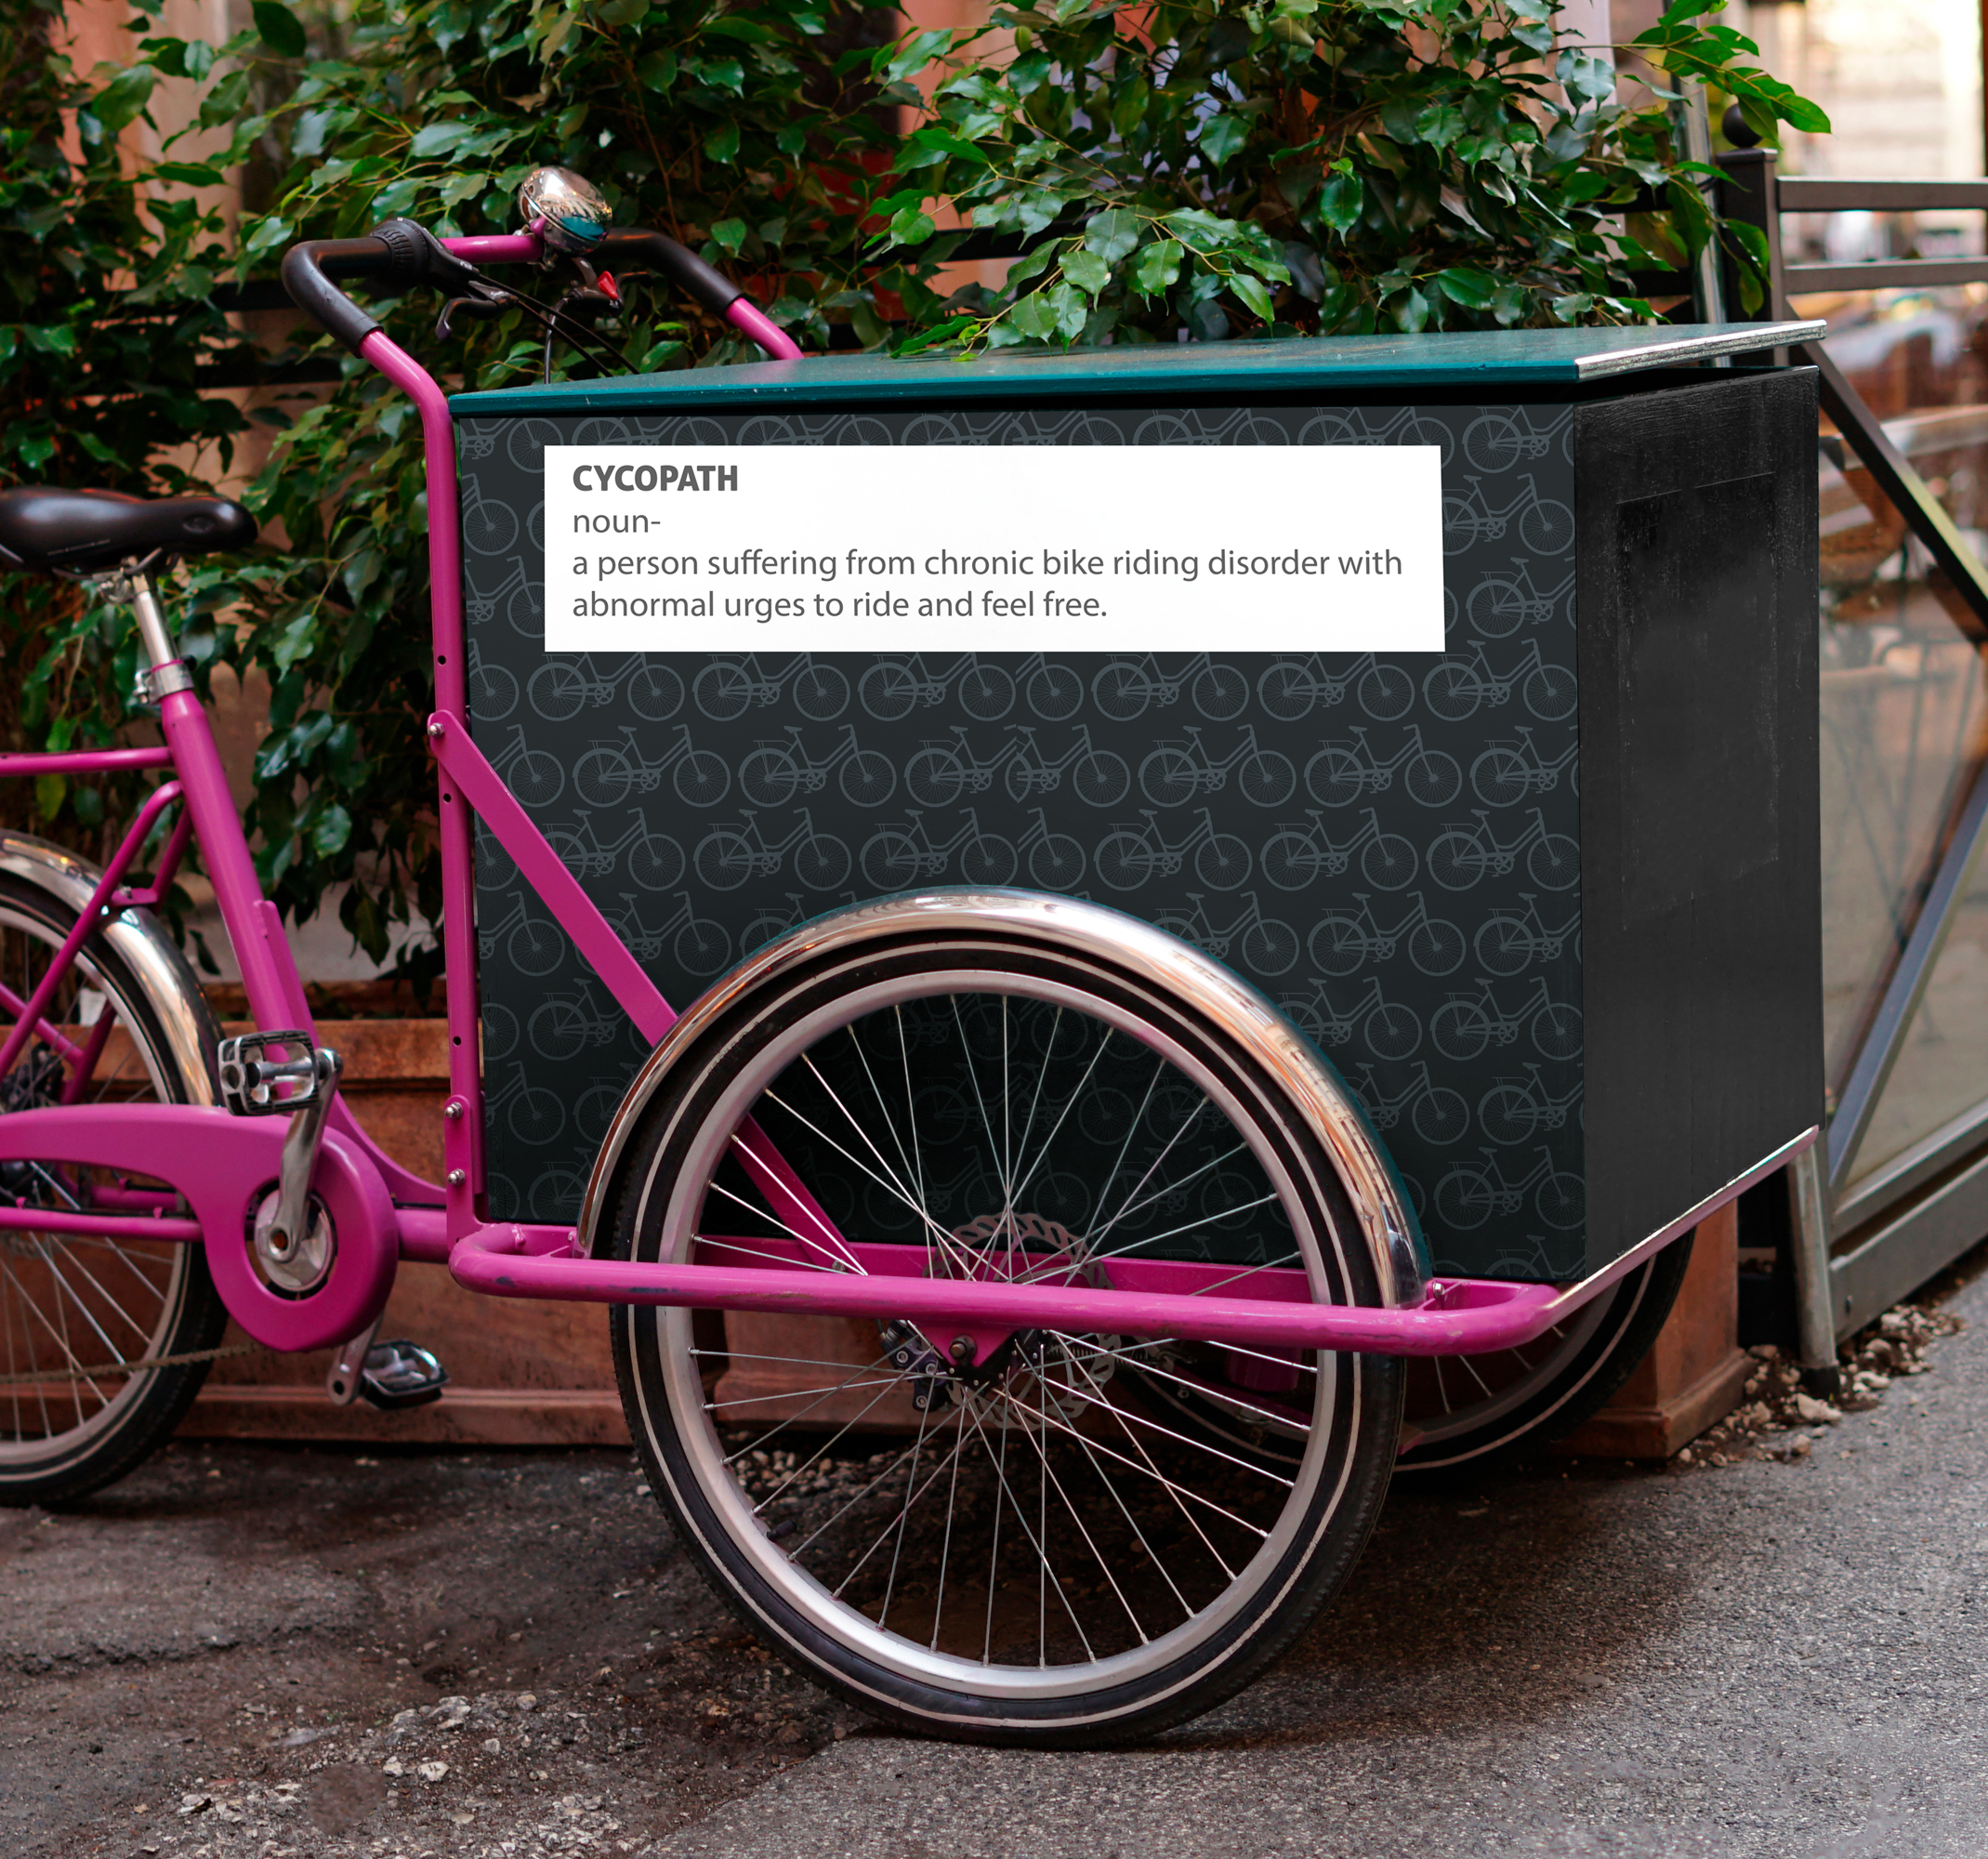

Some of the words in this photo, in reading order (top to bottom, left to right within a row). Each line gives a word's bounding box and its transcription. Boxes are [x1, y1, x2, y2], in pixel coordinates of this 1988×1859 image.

[573, 464, 738, 492] CYCOPATH
[573, 514, 661, 534] noun-
[573, 556, 588, 575] a
[598, 556, 698, 582] person
[707, 547, 836, 583] suffering
[845, 547, 915, 575] from
[924, 548, 1034, 575] chronic
[1043, 548, 1104, 575] bike
[1113, 548, 1199, 583] riding
[1208, 548, 1331, 575] disorder
[1337, 548, 1402, 575] with
[573, 590, 714, 617] abnormal
[724, 598, 806, 625] urges
[812, 593, 844, 617] to
[853, 590, 910, 617] ride
[917, 590, 973, 617] and
[981, 589, 1034, 617] feel
[1042, 589, 1107, 617] free.
